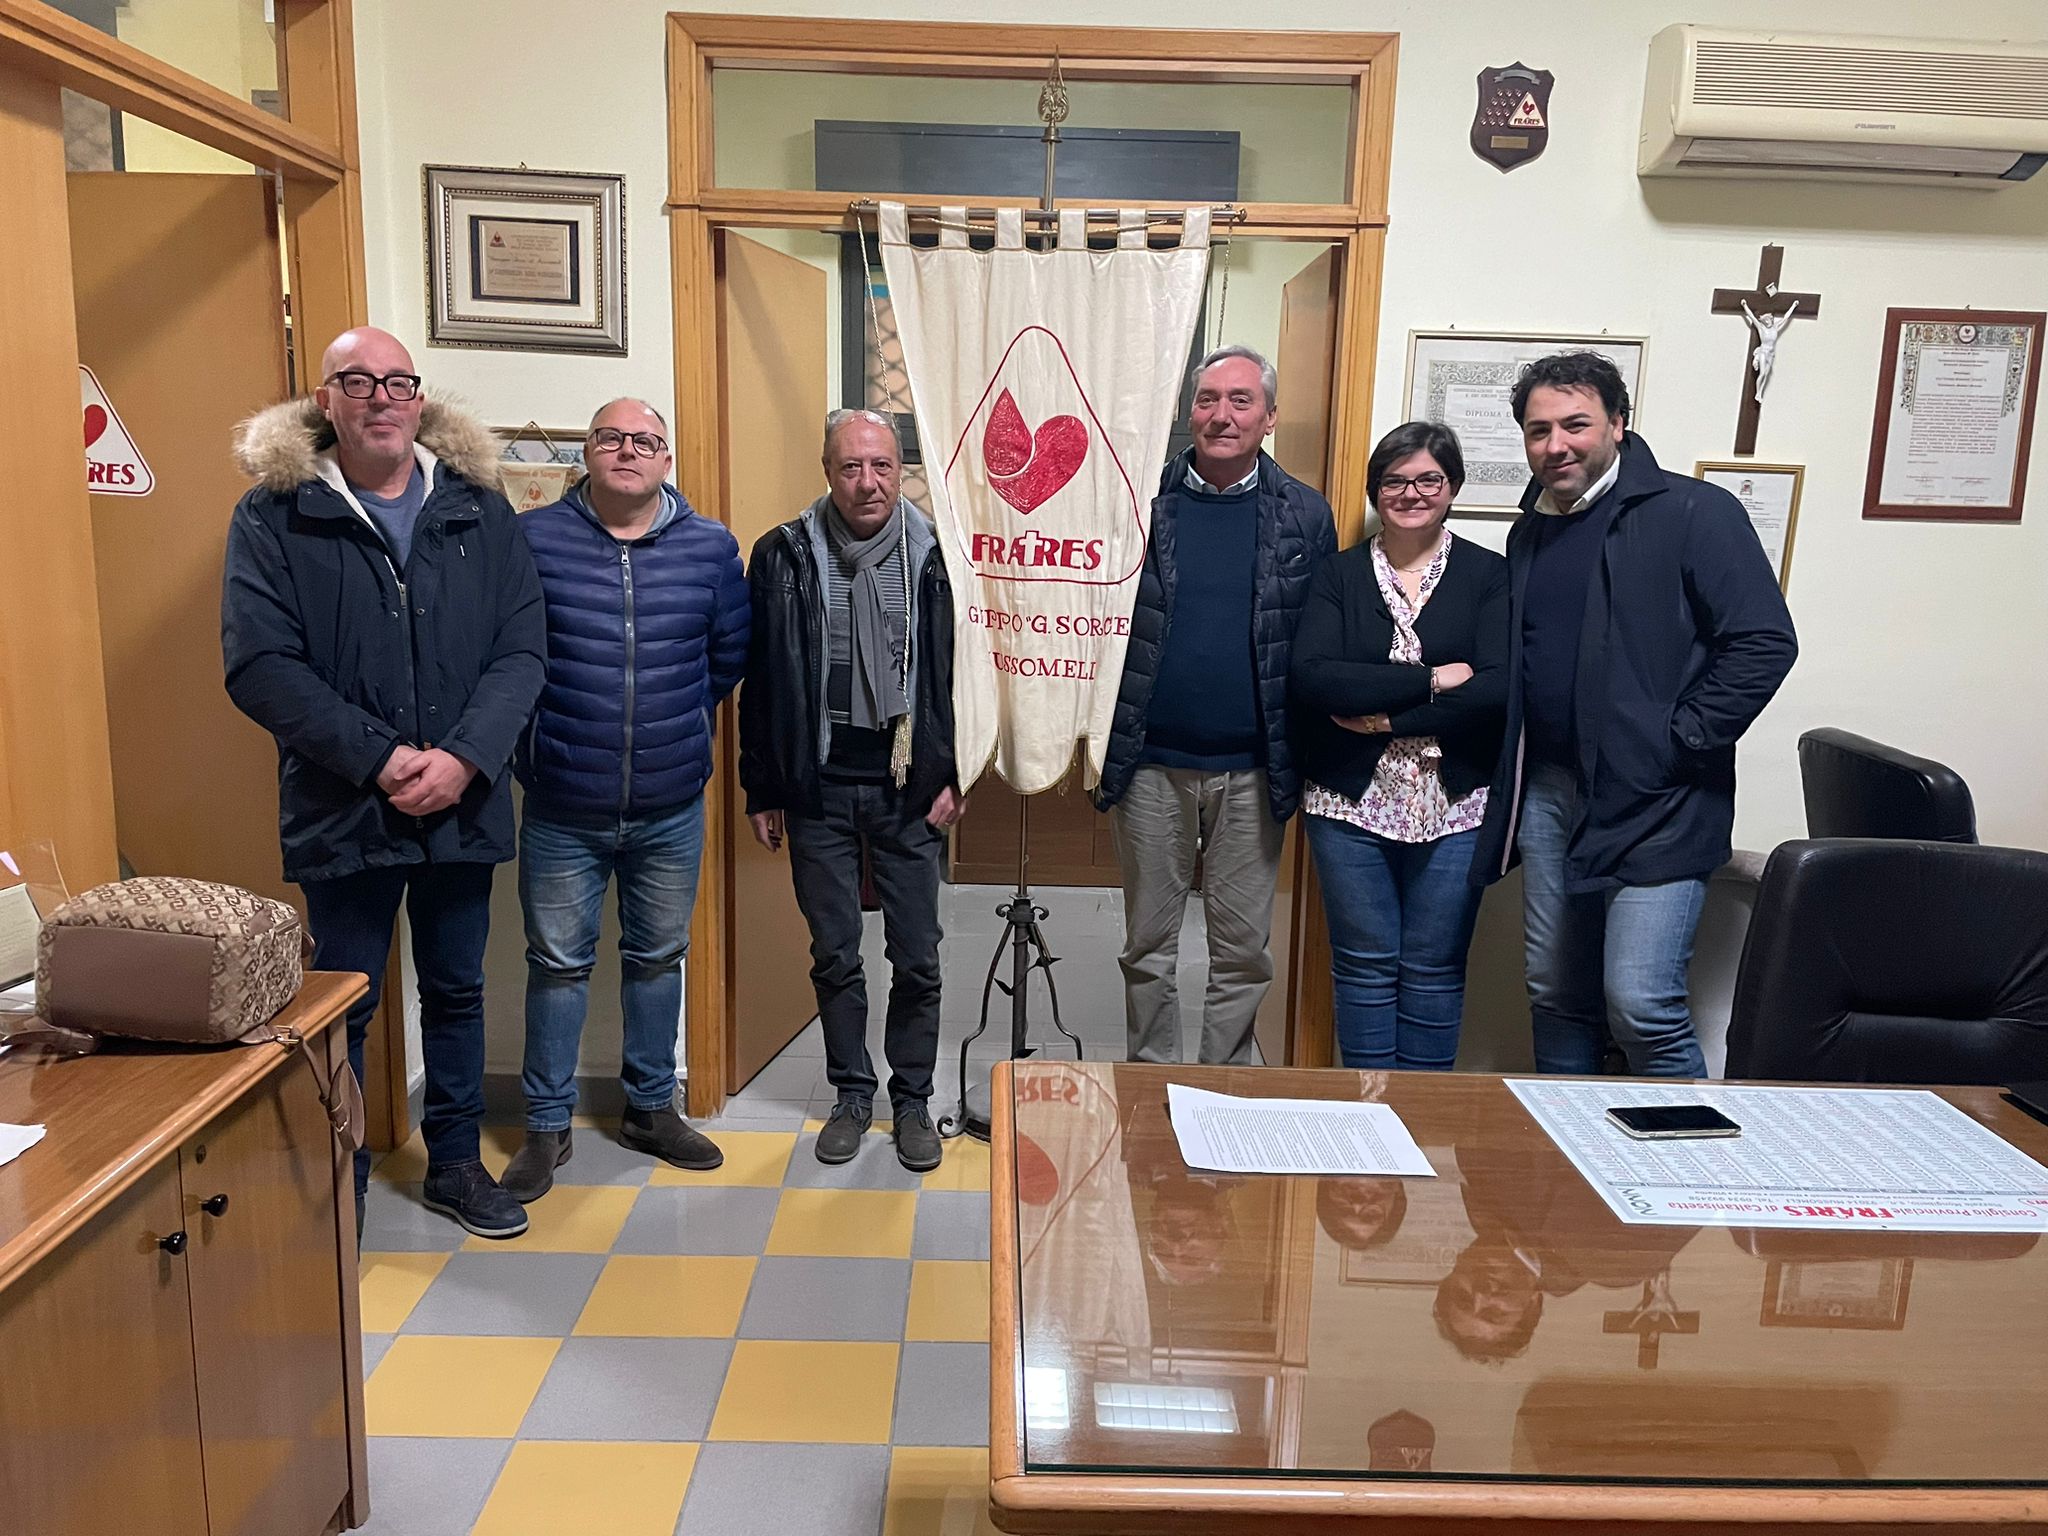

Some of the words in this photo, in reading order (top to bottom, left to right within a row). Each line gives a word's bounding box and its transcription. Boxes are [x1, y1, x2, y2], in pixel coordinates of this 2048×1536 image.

[1465, 410, 1502, 418] DIPLOMA
[972, 530, 1103, 570] FRATRES
[1056, 615, 1129, 637] SORCE
[991, 652, 1096, 680] USSOMELI
[1667, 1201, 1762, 1213] Caltanissetta
[1764, 1204, 1779, 1213] di
[1782, 1204, 1895, 1220] FRATRES
[1892, 1206, 1971, 1217] Provinciale
[1973, 1207, 2038, 1218] Consiglio
